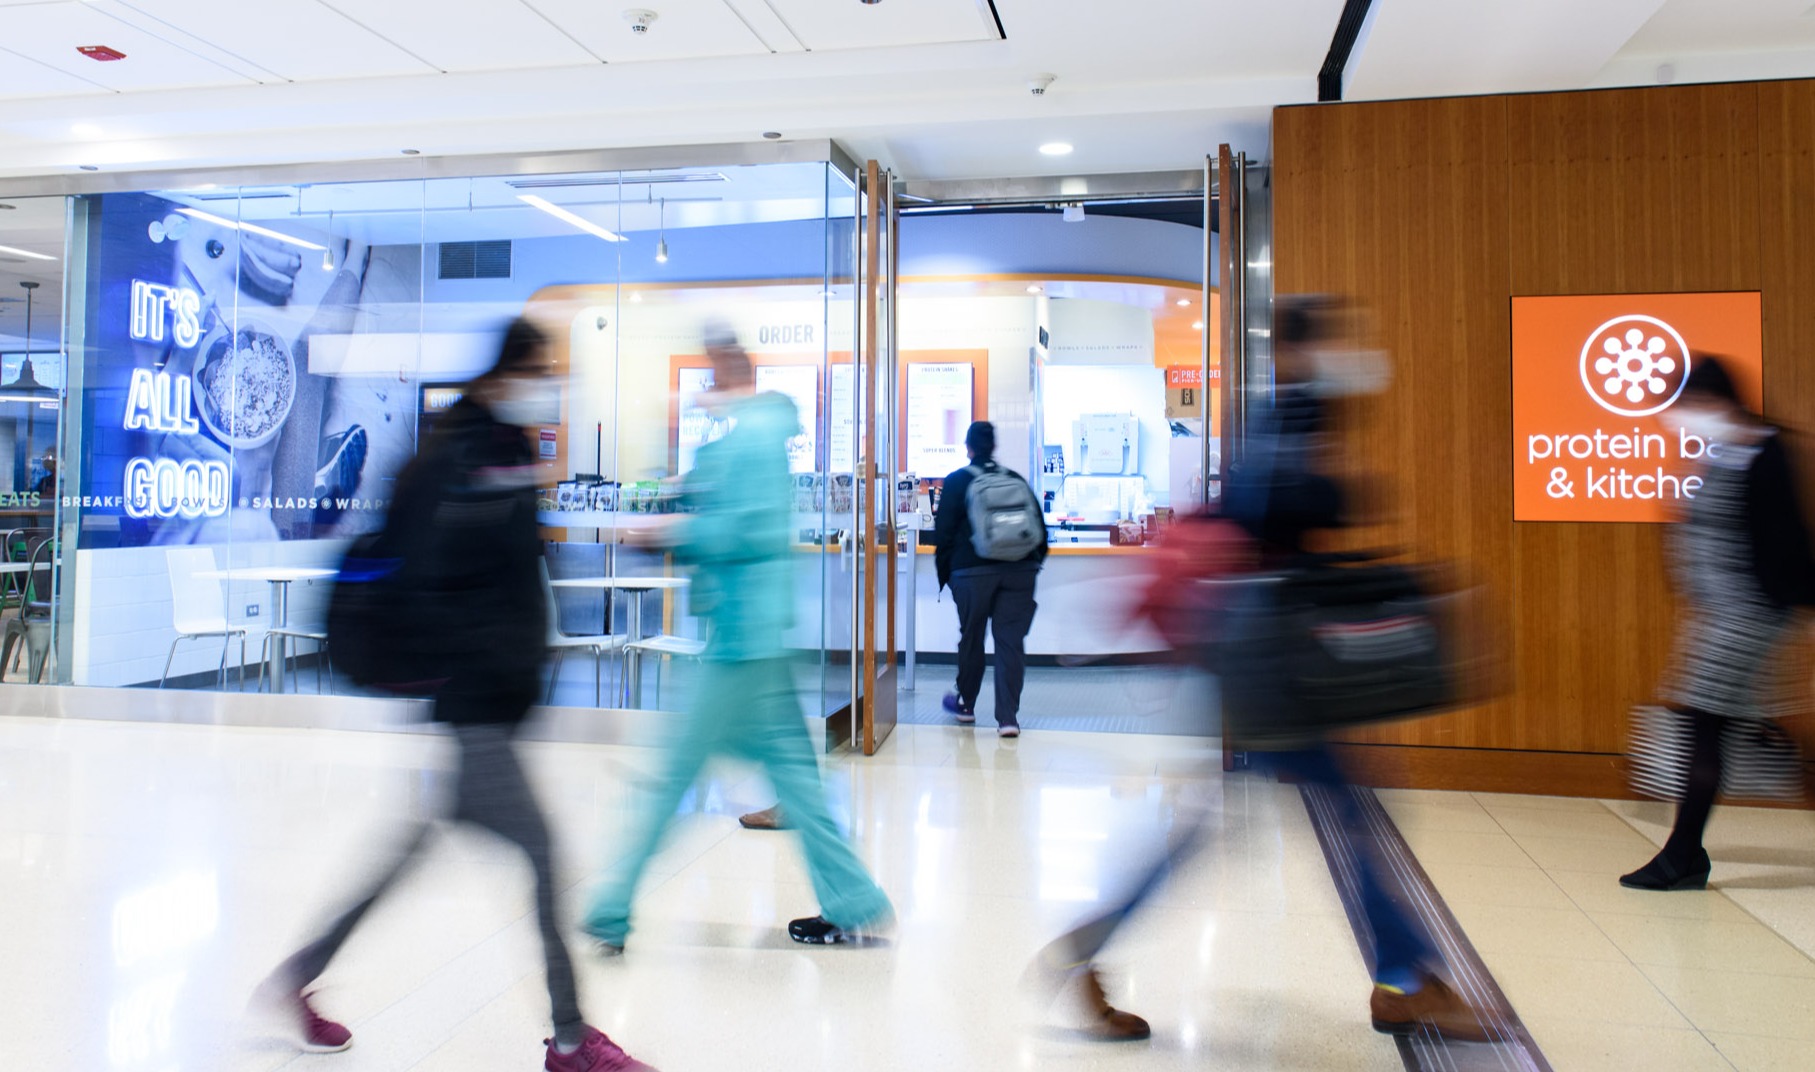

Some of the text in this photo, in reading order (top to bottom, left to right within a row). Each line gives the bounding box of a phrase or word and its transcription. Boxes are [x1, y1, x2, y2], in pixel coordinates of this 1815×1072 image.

[130, 278, 200, 348] IT'S
[758, 324, 814, 344] ORDER
[125, 368, 199, 432] ALL
[1528, 427, 1666, 464] protein
[0, 491, 41, 507] EATS
[123, 457, 229, 519] GOOD
[1546, 466, 1704, 499] & kitche
[252, 497, 318, 509] SALADS
